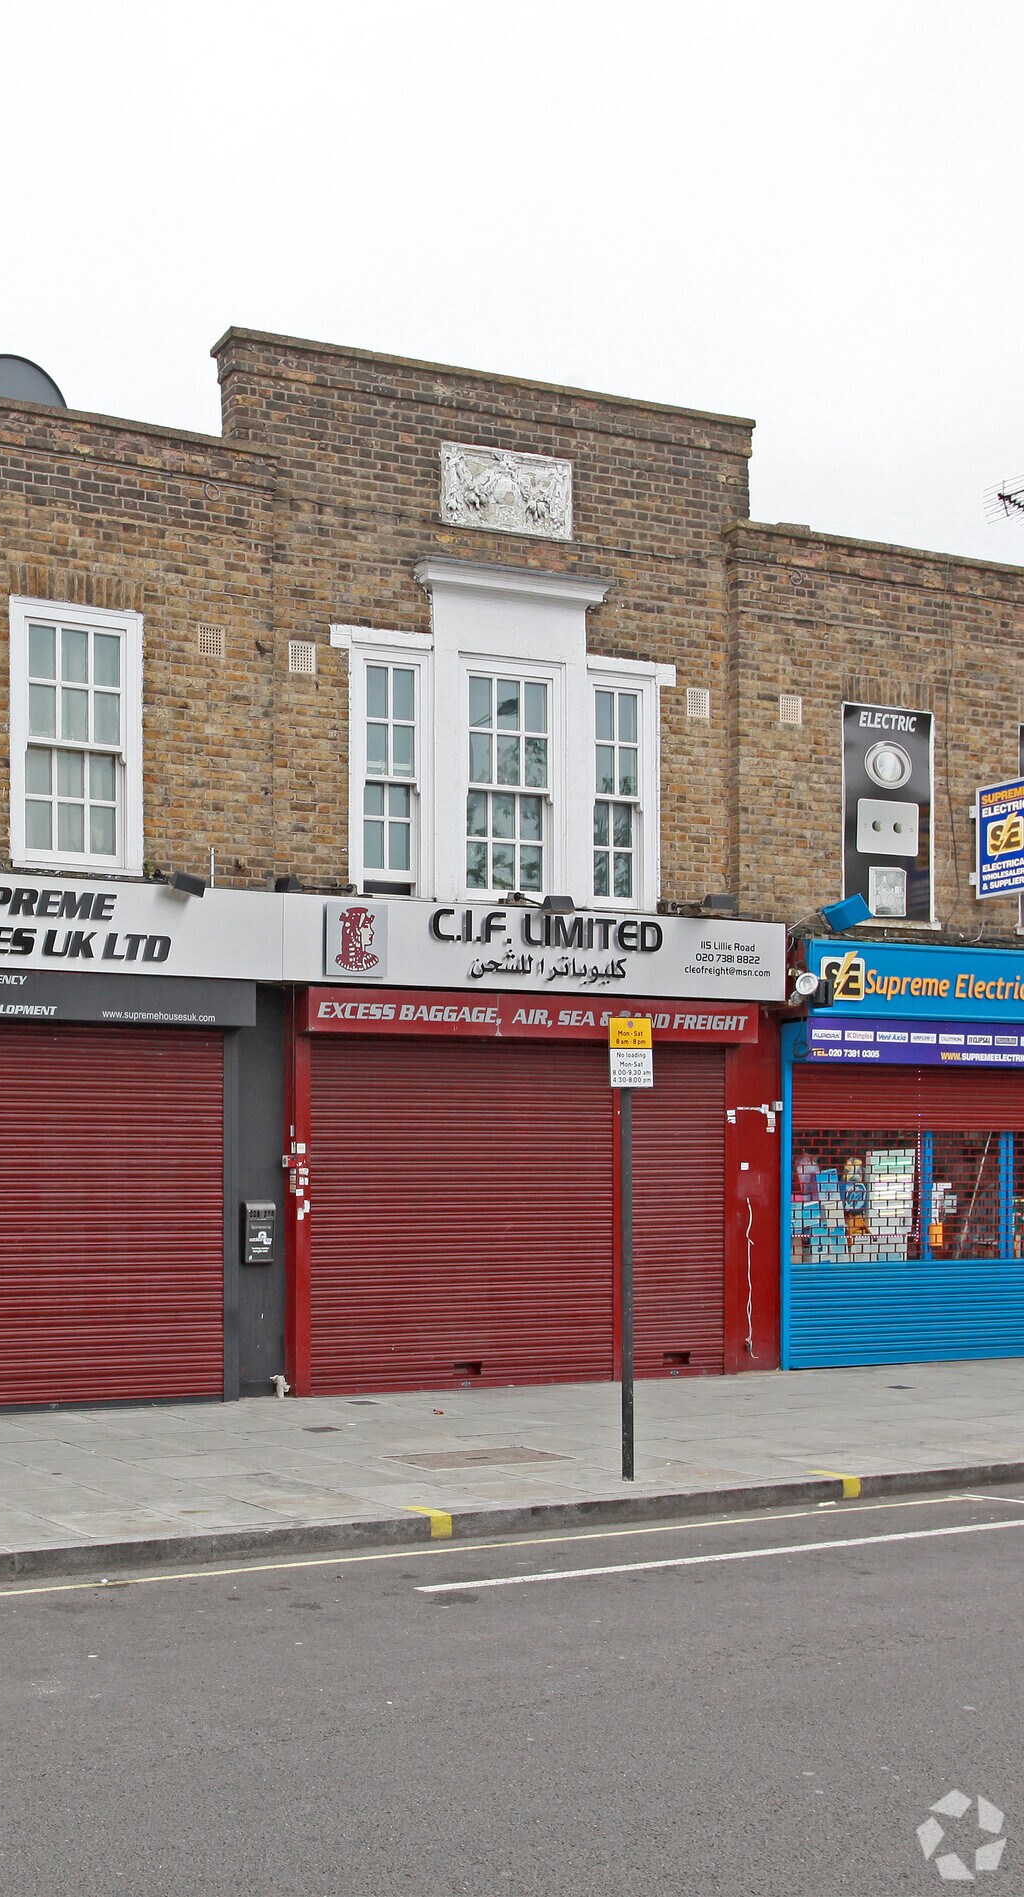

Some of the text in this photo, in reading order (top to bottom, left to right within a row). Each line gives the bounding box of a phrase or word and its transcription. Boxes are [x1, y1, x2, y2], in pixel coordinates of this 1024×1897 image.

[859, 711, 917, 733] ELECTRIC
[981, 785, 1024, 805] SUPREM
[982, 882, 988, 891] &
[430, 908, 663, 953] C.I.F. LIMITED
[41, 929, 98, 960] UK
[102, 932, 172, 963] LTD
[700, 940, 756, 952] 115 Lillie Road
[470, 948, 534, 979] للشحن
[695, 953, 761, 965] 020 7381 8822
[684, 964, 771, 977] cleofreight@msn.com
[865, 969, 950, 1000] Supreme
[102, 1010, 216, 1022] www.supremehousesuk.com
[317, 1001, 397, 1020] EXCESS
[399, 1004, 502, 1026] BAGGAGE,
[511, 1008, 553, 1028] AIR,
[557, 1010, 596, 1027] SEA
[599, 1011, 613, 1027] &
[673, 1013, 749, 1031] FREIGHT
[828, 1049, 842, 1057] 020
[862, 1050, 880, 1058] 0305
[940, 1052, 1024, 1062] WWW.SUPREMEELECTRI
